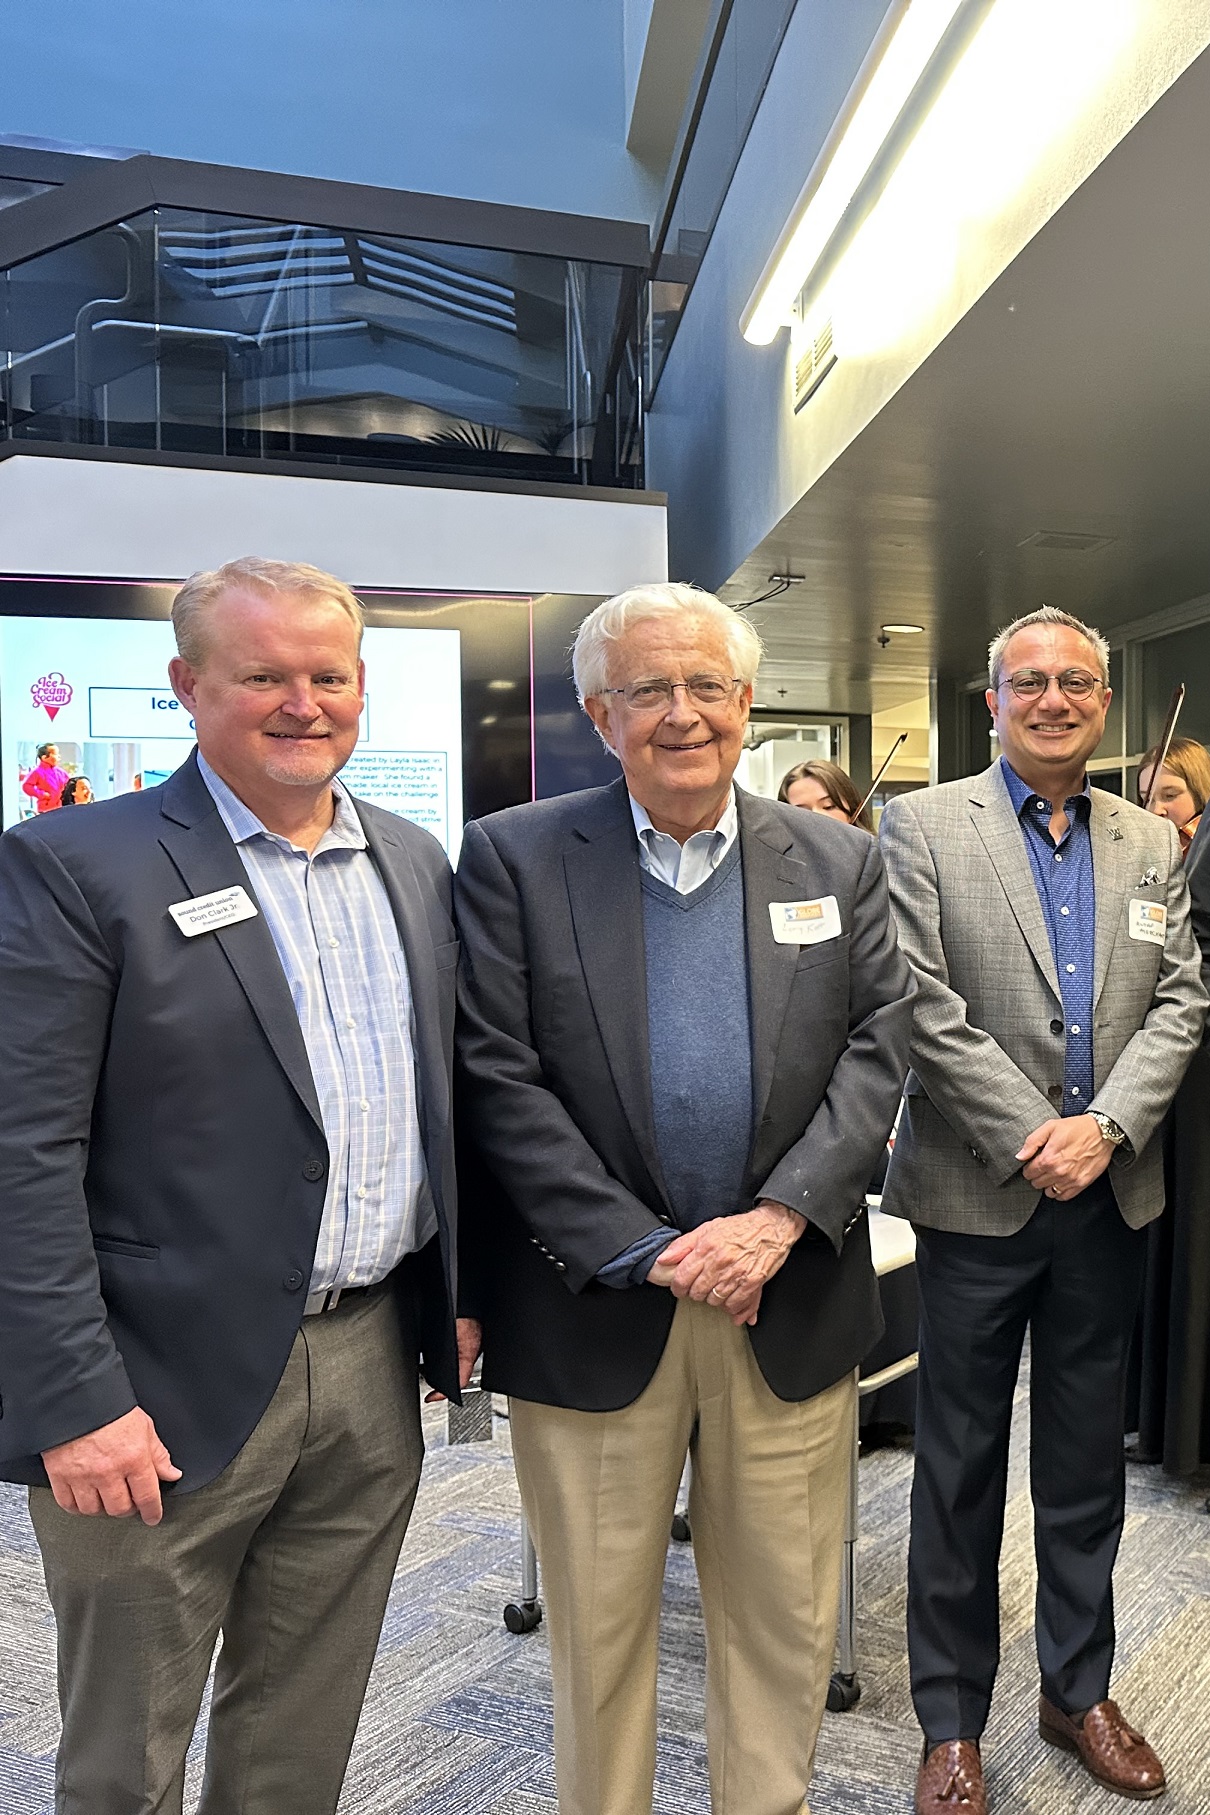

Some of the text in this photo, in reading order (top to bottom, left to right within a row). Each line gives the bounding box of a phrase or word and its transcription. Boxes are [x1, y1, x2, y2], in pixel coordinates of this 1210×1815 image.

[37, 676, 58, 688] Ice
[30, 683, 67, 695] Cream
[32, 694, 66, 708] Social
[151, 697, 179, 710] Ice
[177, 896, 234, 917] sound credit union
[189, 913, 208, 923] Don
[207, 905, 230, 917] Clark
